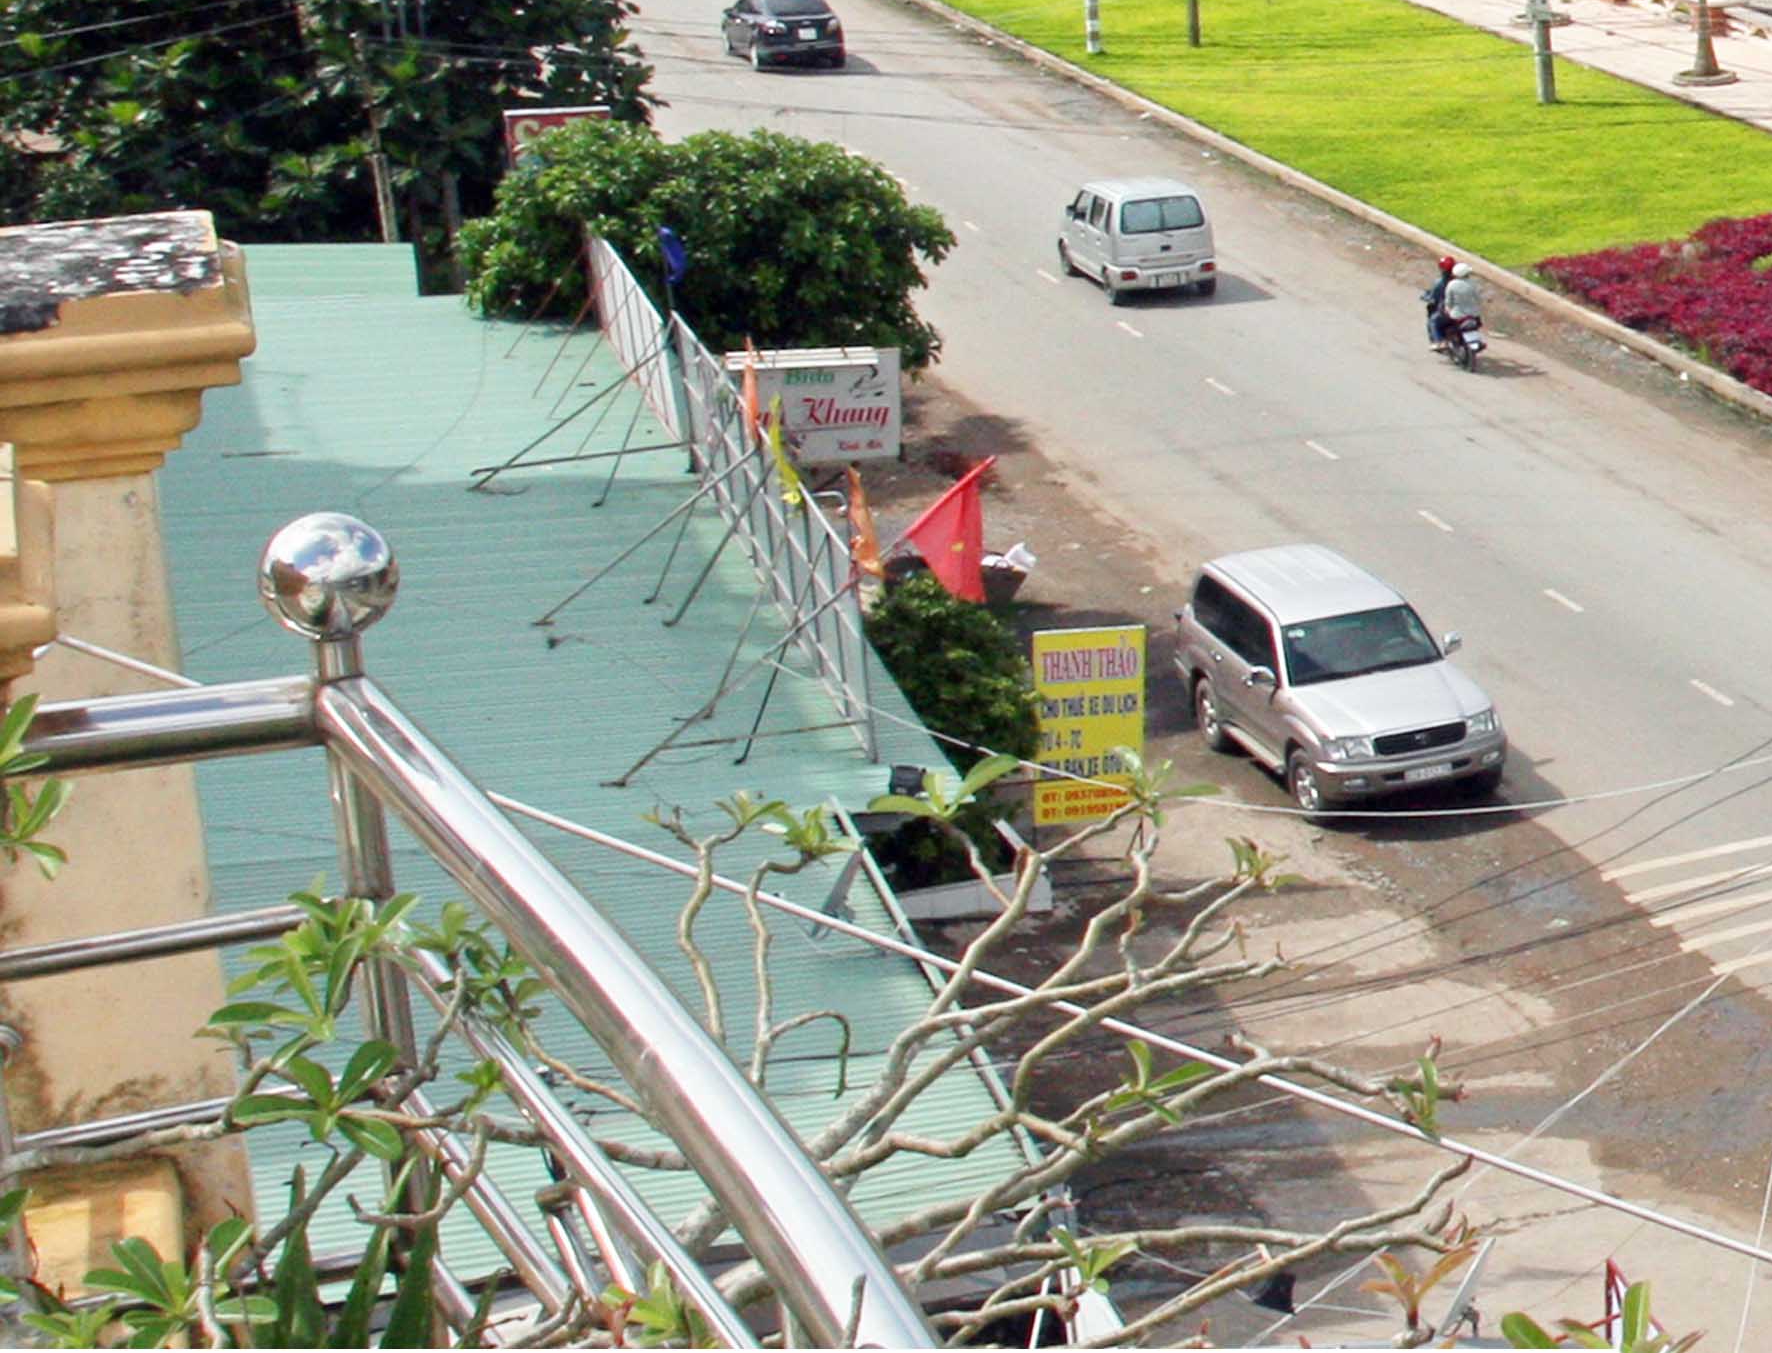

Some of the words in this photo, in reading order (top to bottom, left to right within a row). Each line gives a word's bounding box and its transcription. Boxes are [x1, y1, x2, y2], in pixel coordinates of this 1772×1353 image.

[803, 397, 891, 428] Khang
[1041, 650, 1092, 683] THANH
[1096, 634, 1137, 679] THẢO
